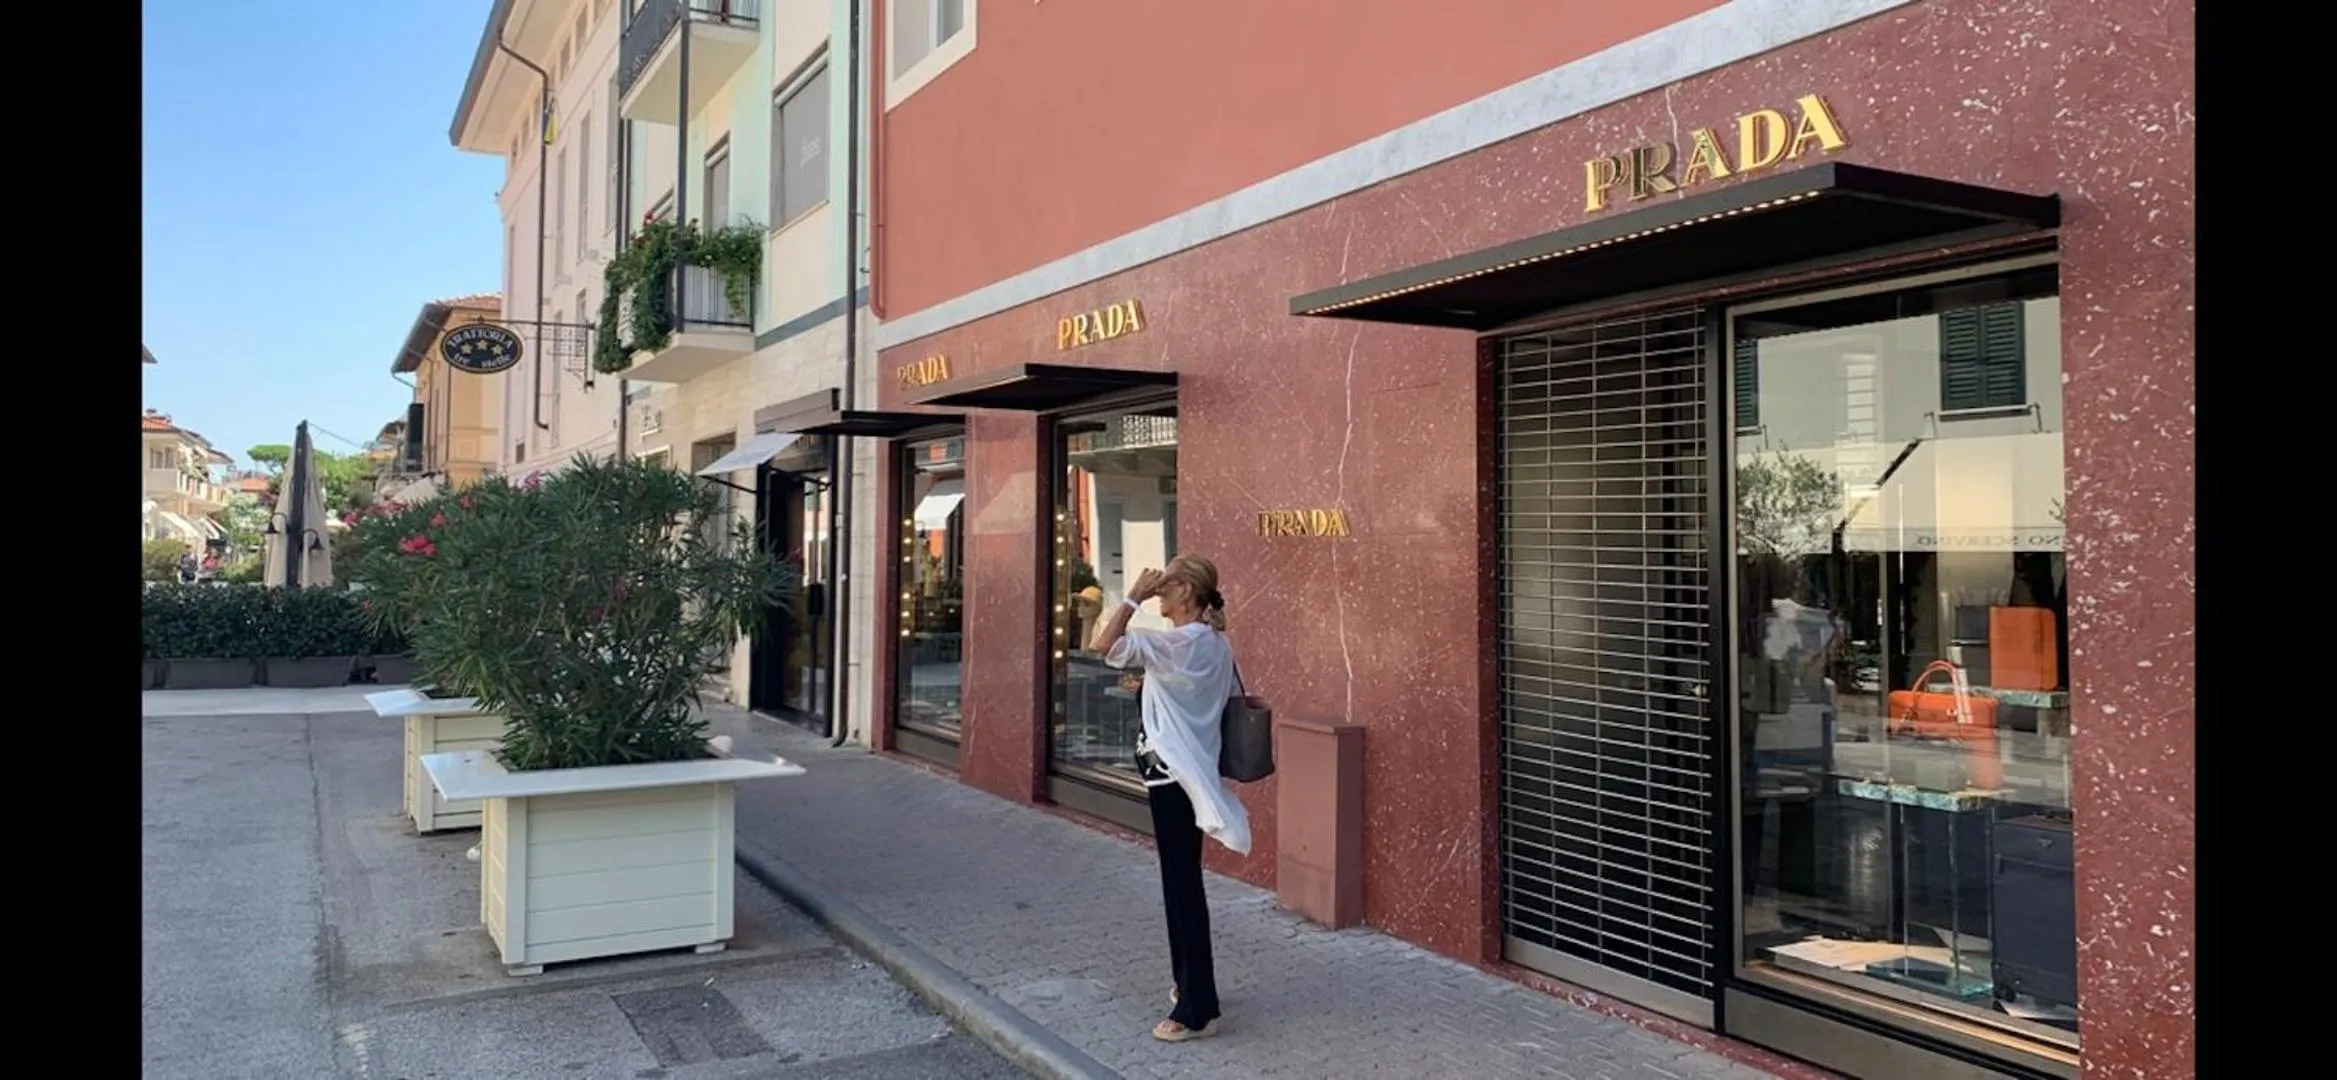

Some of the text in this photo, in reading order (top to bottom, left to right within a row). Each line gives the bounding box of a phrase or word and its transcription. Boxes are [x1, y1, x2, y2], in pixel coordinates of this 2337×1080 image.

[1584, 93, 1846, 213] PRADA
[447, 329, 513, 350] TRATTORIA
[1057, 299, 1143, 350] PRADA
[897, 355, 949, 388] PRADA
[1258, 509, 1351, 537] PRADA
